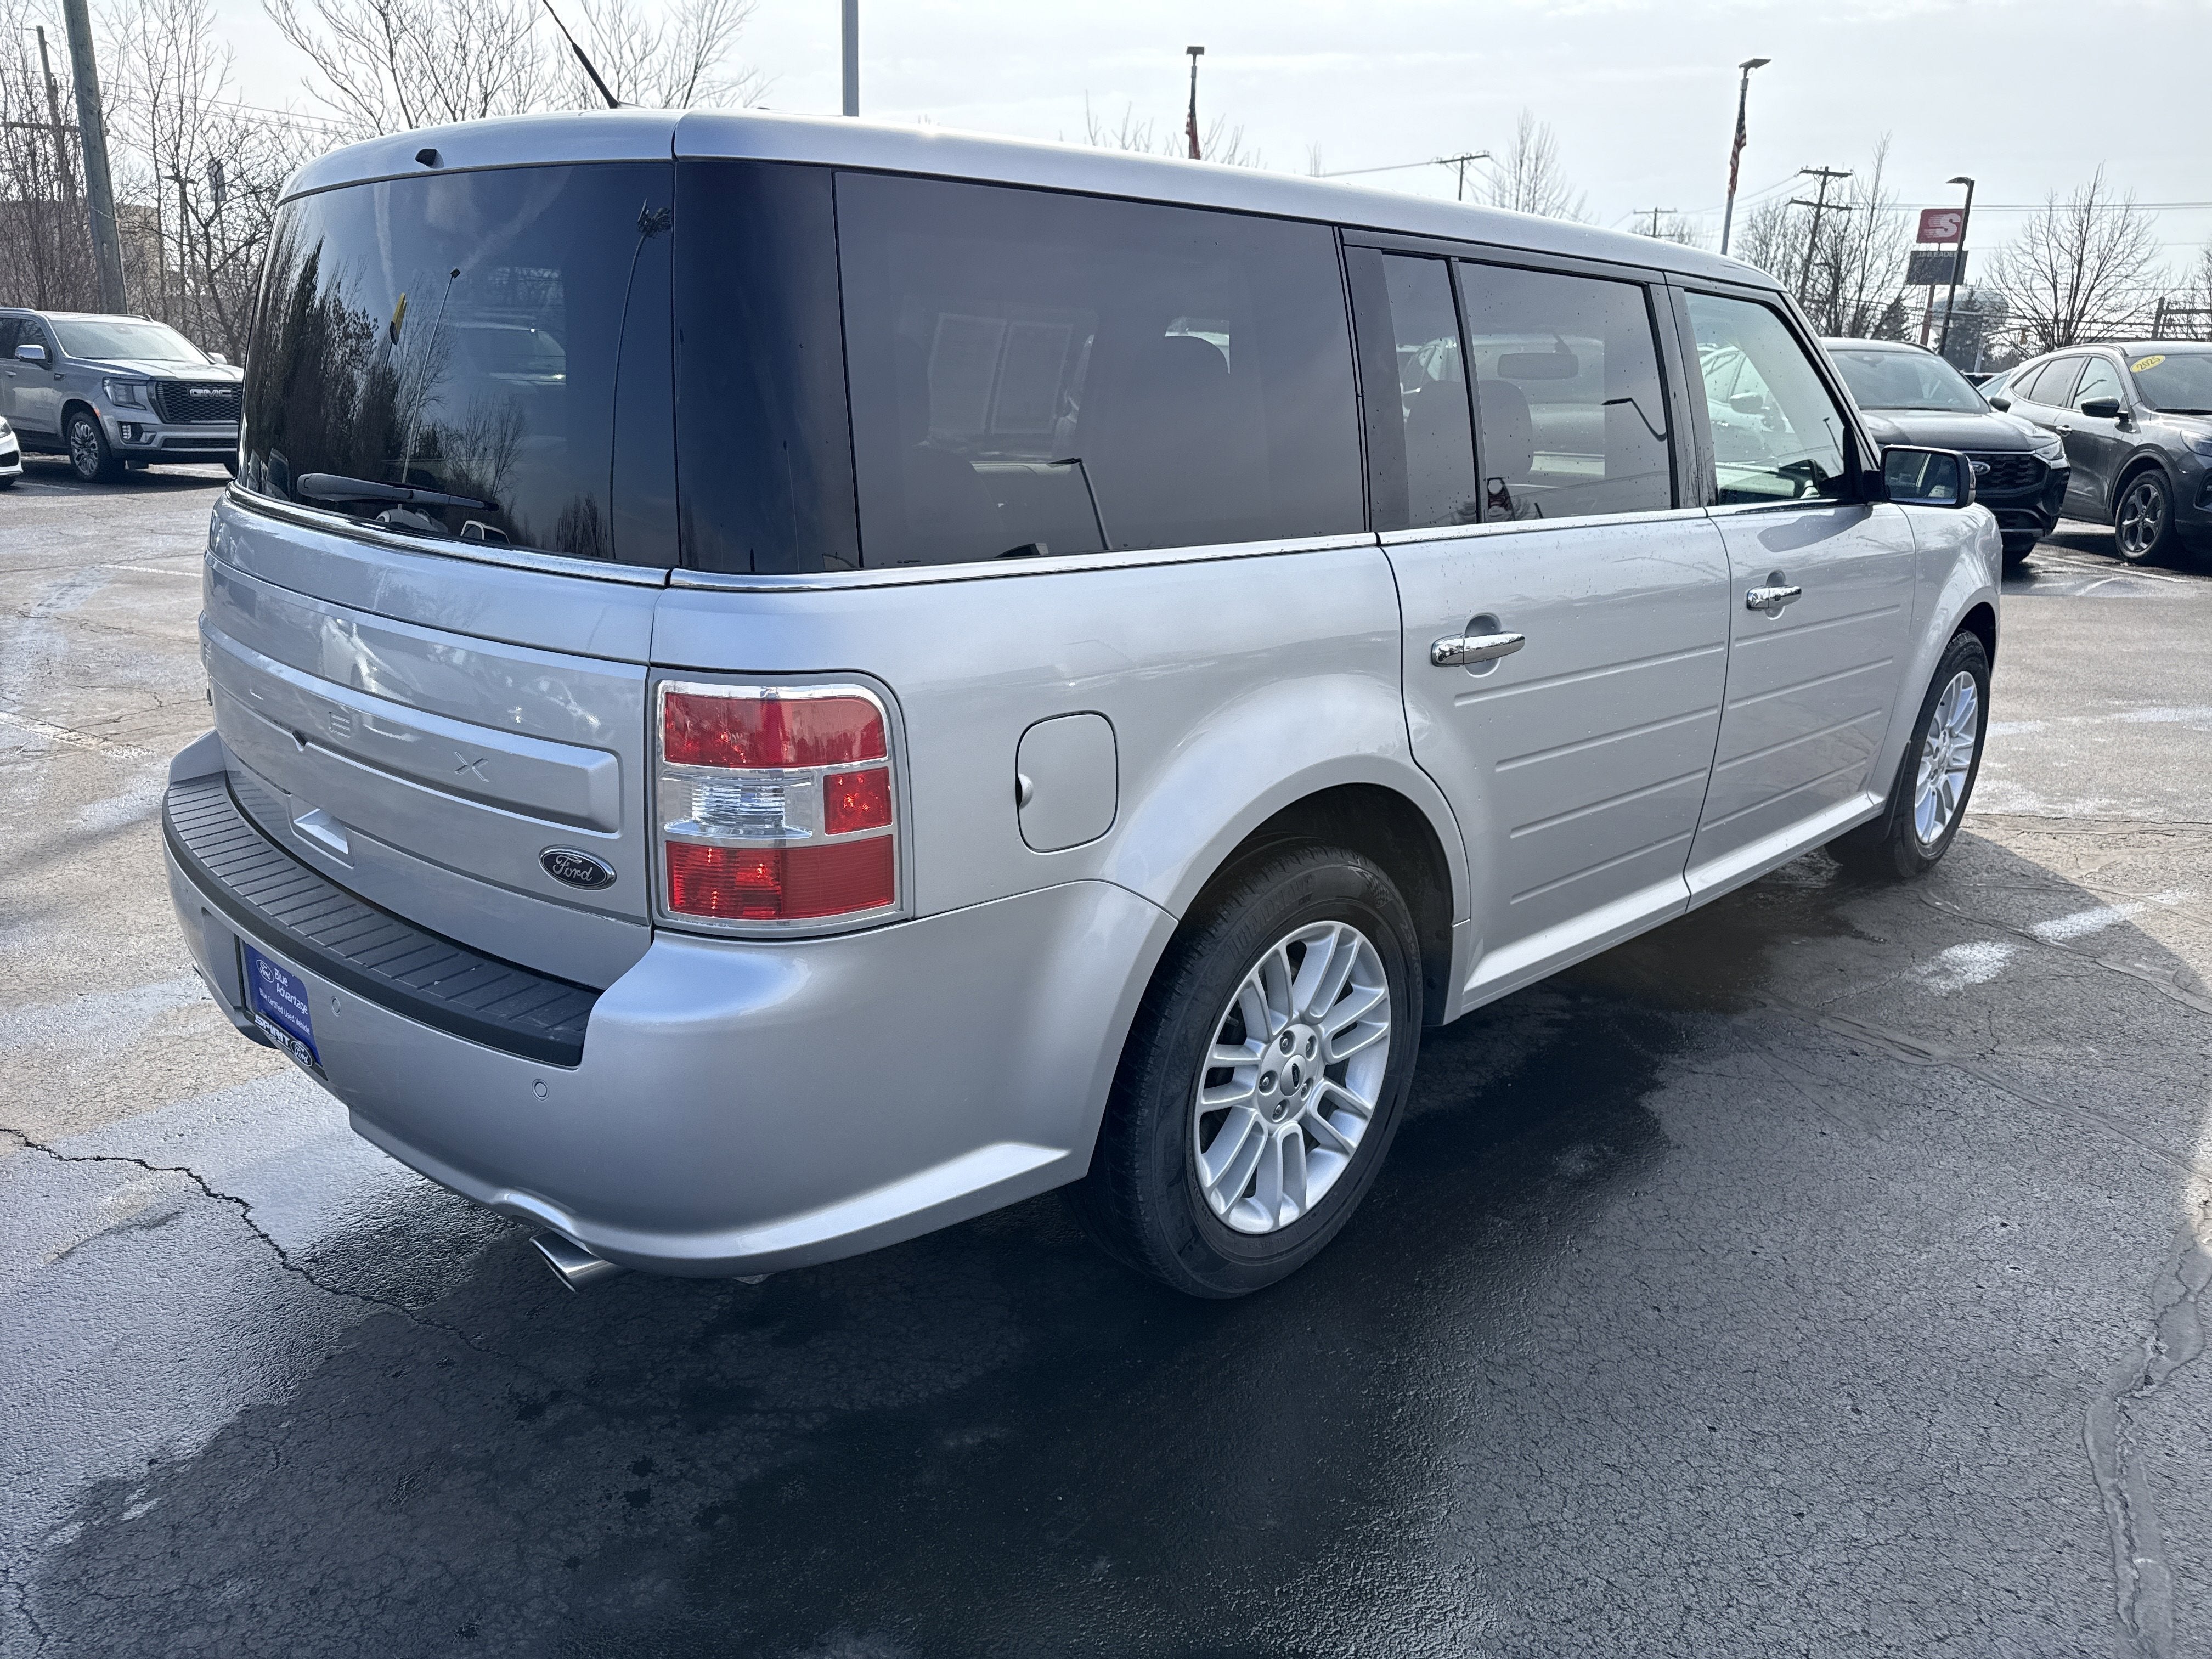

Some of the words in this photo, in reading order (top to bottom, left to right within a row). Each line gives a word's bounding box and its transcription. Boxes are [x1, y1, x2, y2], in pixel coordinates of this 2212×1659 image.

[2136, 356, 2160, 370] 2025
[189, 388, 232, 398] GMC
[552, 855, 594, 882] Ford
[259, 962, 271, 981] Ford
[274, 967, 289, 987] Blue
[276, 983, 308, 1015] Advantage
[259, 988, 268, 1001] Blue
[267, 995, 284, 1015] Certified
[284, 1008, 295, 1023] Used
[295, 1017, 311, 1035] Vehicle
[255, 1014, 290, 1046] SPIRIT
[295, 1043, 308, 1064] Ford
